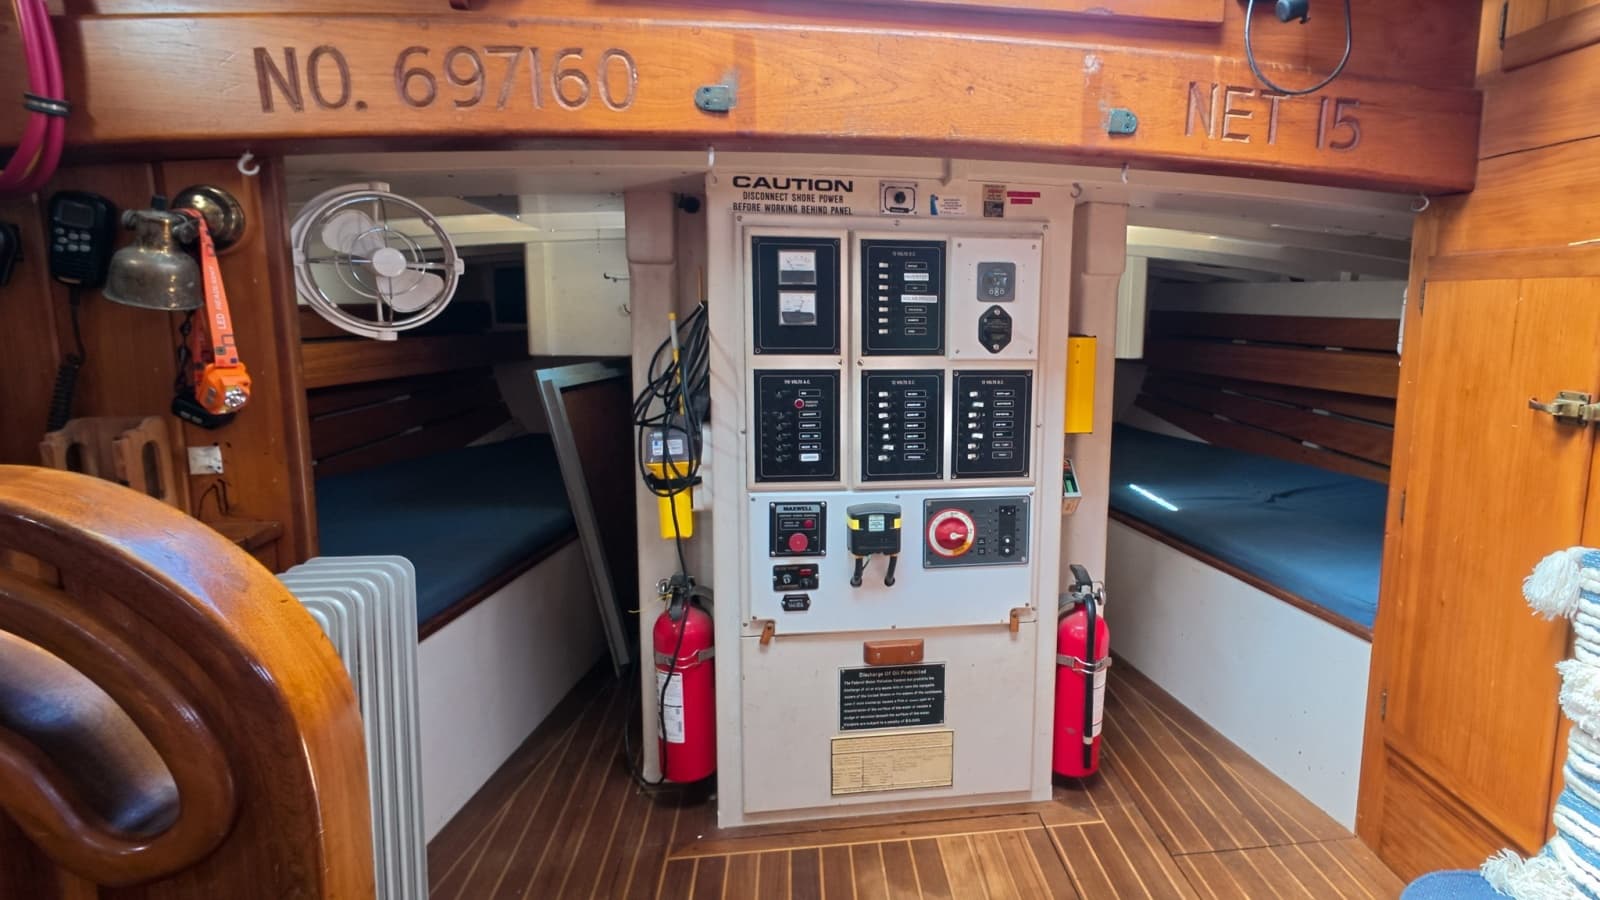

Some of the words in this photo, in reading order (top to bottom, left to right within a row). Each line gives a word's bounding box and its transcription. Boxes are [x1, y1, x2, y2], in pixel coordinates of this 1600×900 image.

[253, 44, 369, 113] NO.
[393, 45, 638, 113] 697160
[1185, 81, 1291, 145] NET
[1316, 95, 1361, 151] 15
[732, 176, 854, 192] CAUTION
[743, 192, 788, 202] DISCONNECT
[791, 193, 816, 203] SHORE
[818, 195, 844, 204] POWER
[732, 202, 761, 212] BEFORE
[764, 204, 798, 214] WORKING
[800, 206, 828, 214] BEHIND
[830, 207, 854, 216] PANEL
[215, 313, 226, 330] LED
